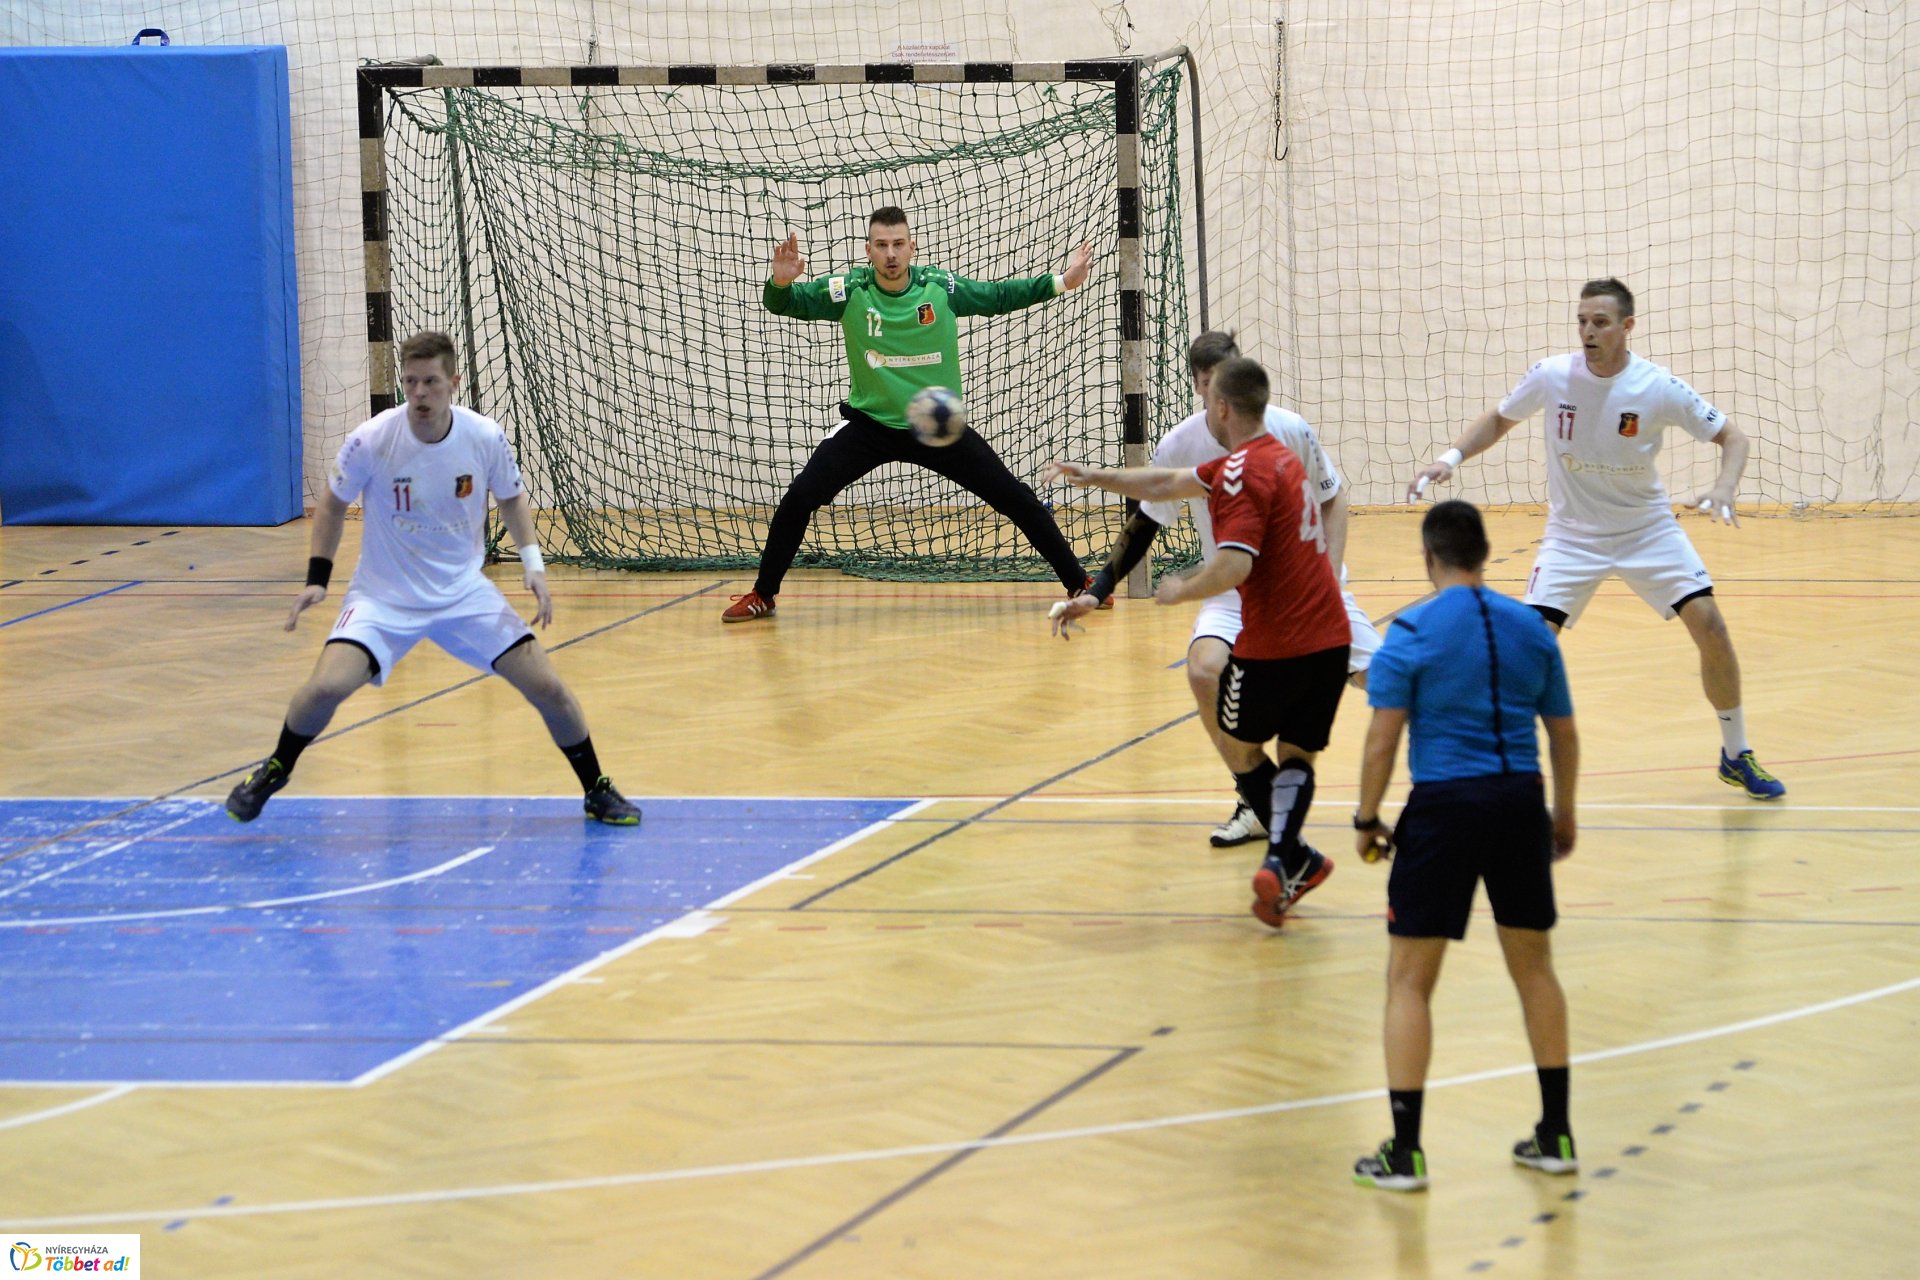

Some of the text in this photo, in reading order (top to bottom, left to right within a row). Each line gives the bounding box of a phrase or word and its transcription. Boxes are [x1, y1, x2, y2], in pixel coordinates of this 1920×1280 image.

[866, 312, 883, 337] 12
[1558, 402, 1577, 411] JAKO
[1558, 411, 1576, 441] 17
[393, 483, 411, 512] 11
[1301, 479, 1328, 554] 4
